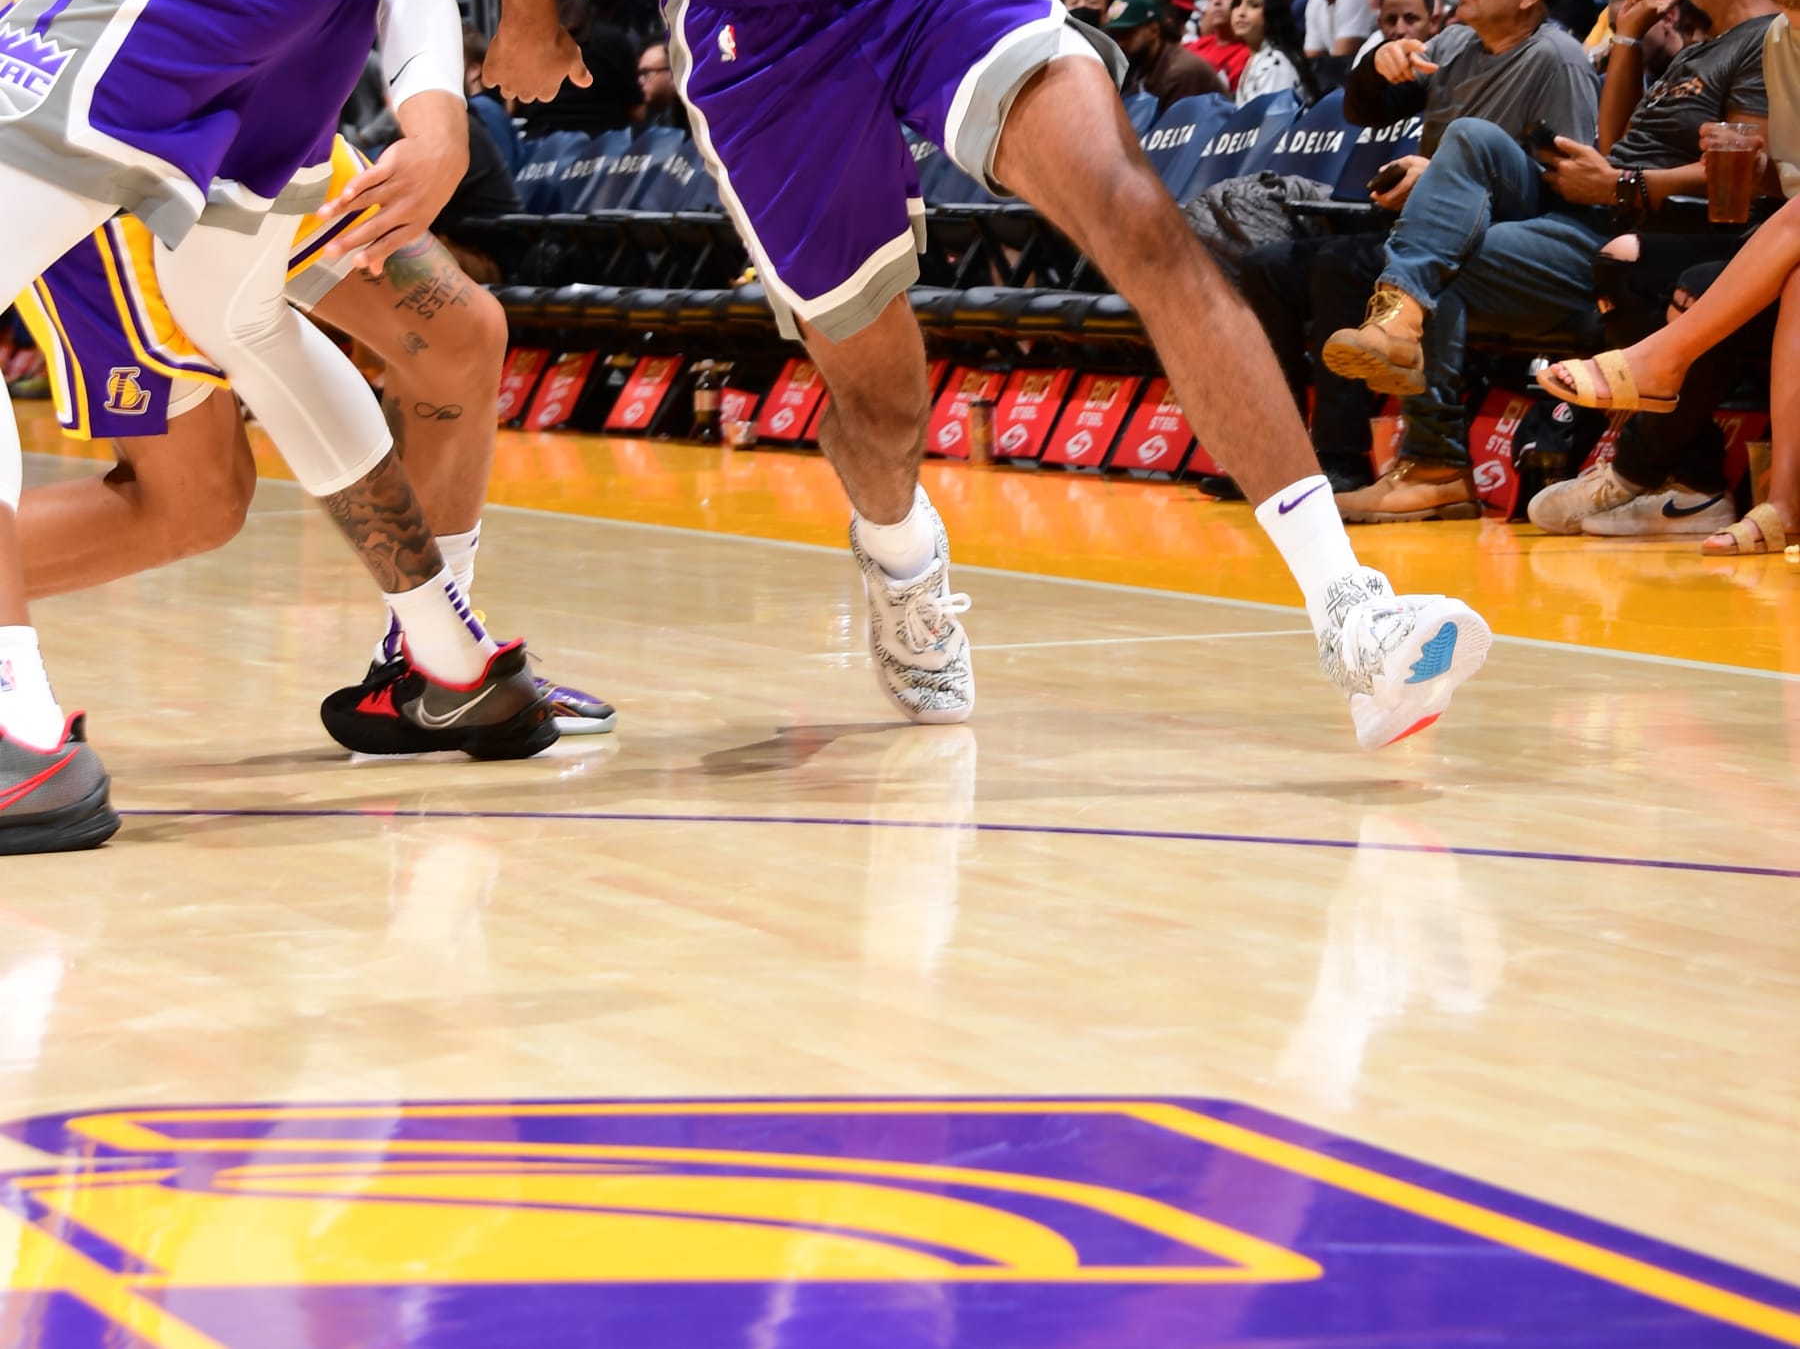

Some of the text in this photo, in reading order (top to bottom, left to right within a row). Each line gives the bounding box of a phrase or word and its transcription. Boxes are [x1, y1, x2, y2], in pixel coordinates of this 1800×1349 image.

[1146, 124, 1196, 151] DELTA
[1214, 127, 1260, 156] DELTA
[1289, 130, 1346, 154] DELTA
[394, 276, 441, 310] FINAL
